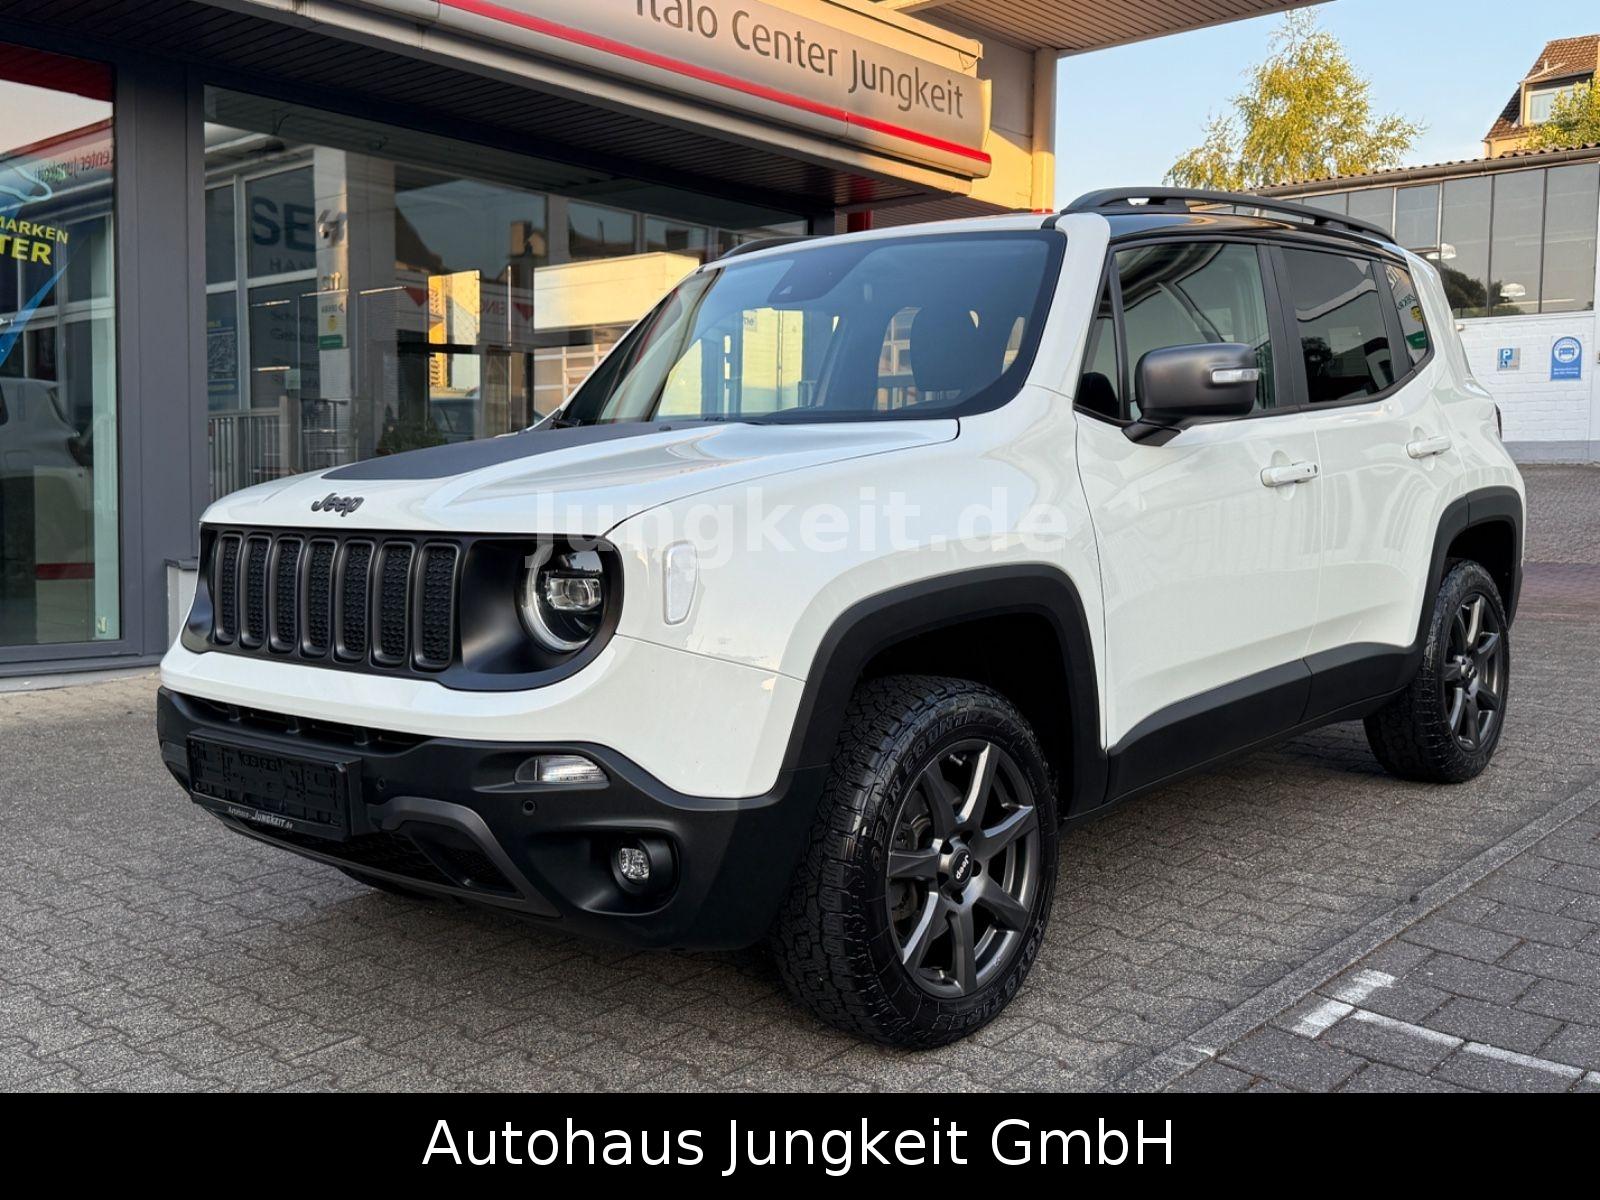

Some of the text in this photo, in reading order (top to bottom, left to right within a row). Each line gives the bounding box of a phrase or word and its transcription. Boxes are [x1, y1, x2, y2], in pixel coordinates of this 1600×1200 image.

[731, 9, 838, 77] Center
[847, 49, 964, 119] Jungkeit
[1502, 349, 1511, 360] P
[311, 492, 364, 517] Jeep
[955, 854, 969, 880] Jeep
